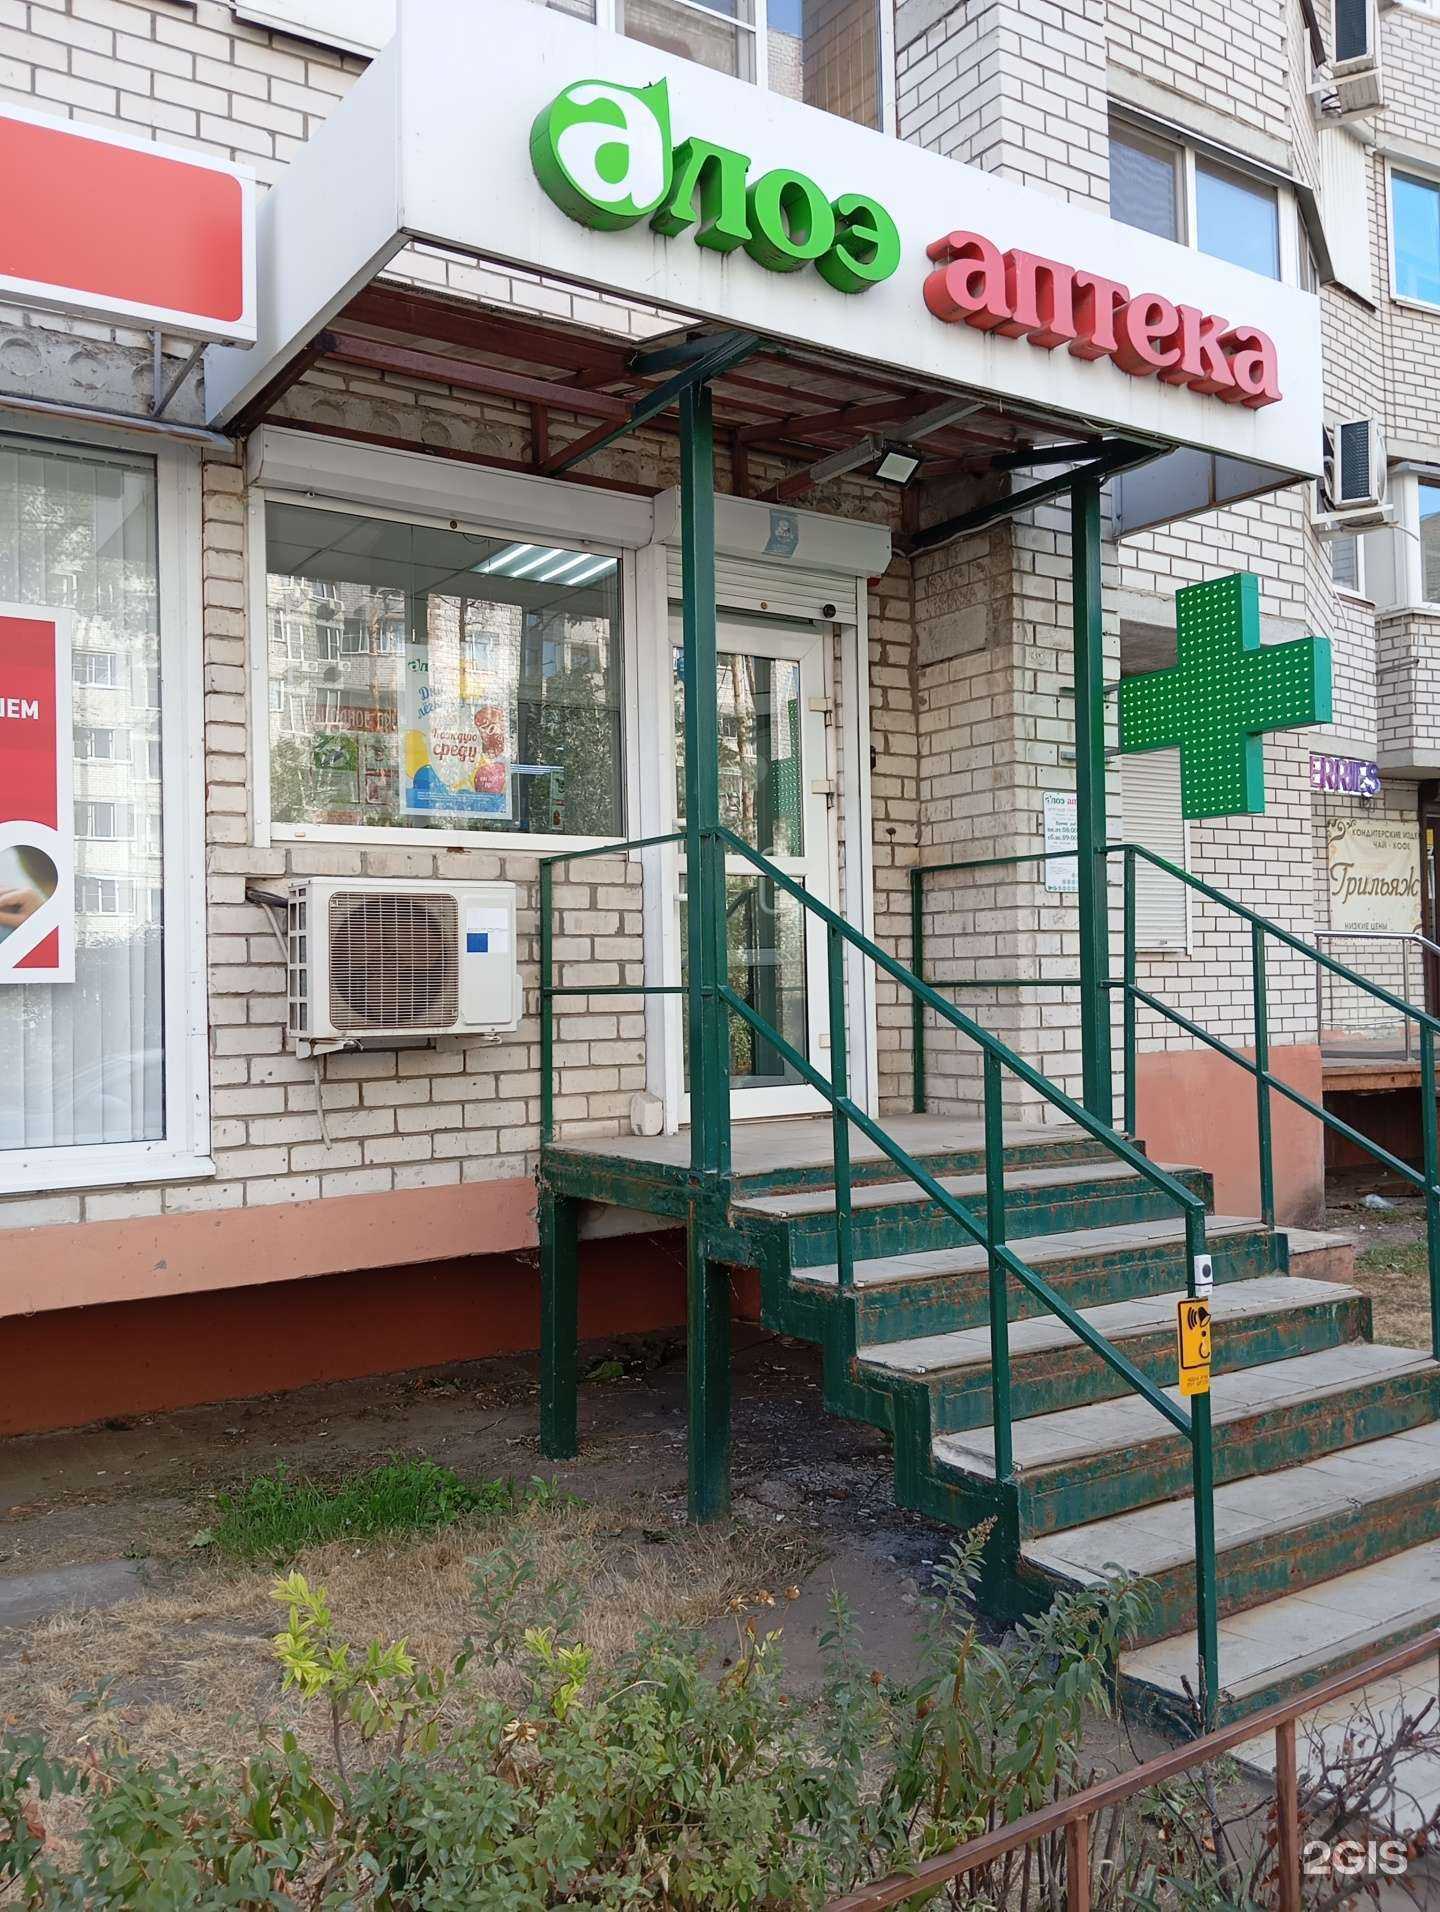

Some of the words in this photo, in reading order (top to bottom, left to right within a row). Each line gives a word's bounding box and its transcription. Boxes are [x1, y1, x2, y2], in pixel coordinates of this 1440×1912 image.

[923, 230, 1283, 409] аптека
[1309, 755, 1381, 795] ERRIES
[1329, 862, 1421, 905] Грильяж
